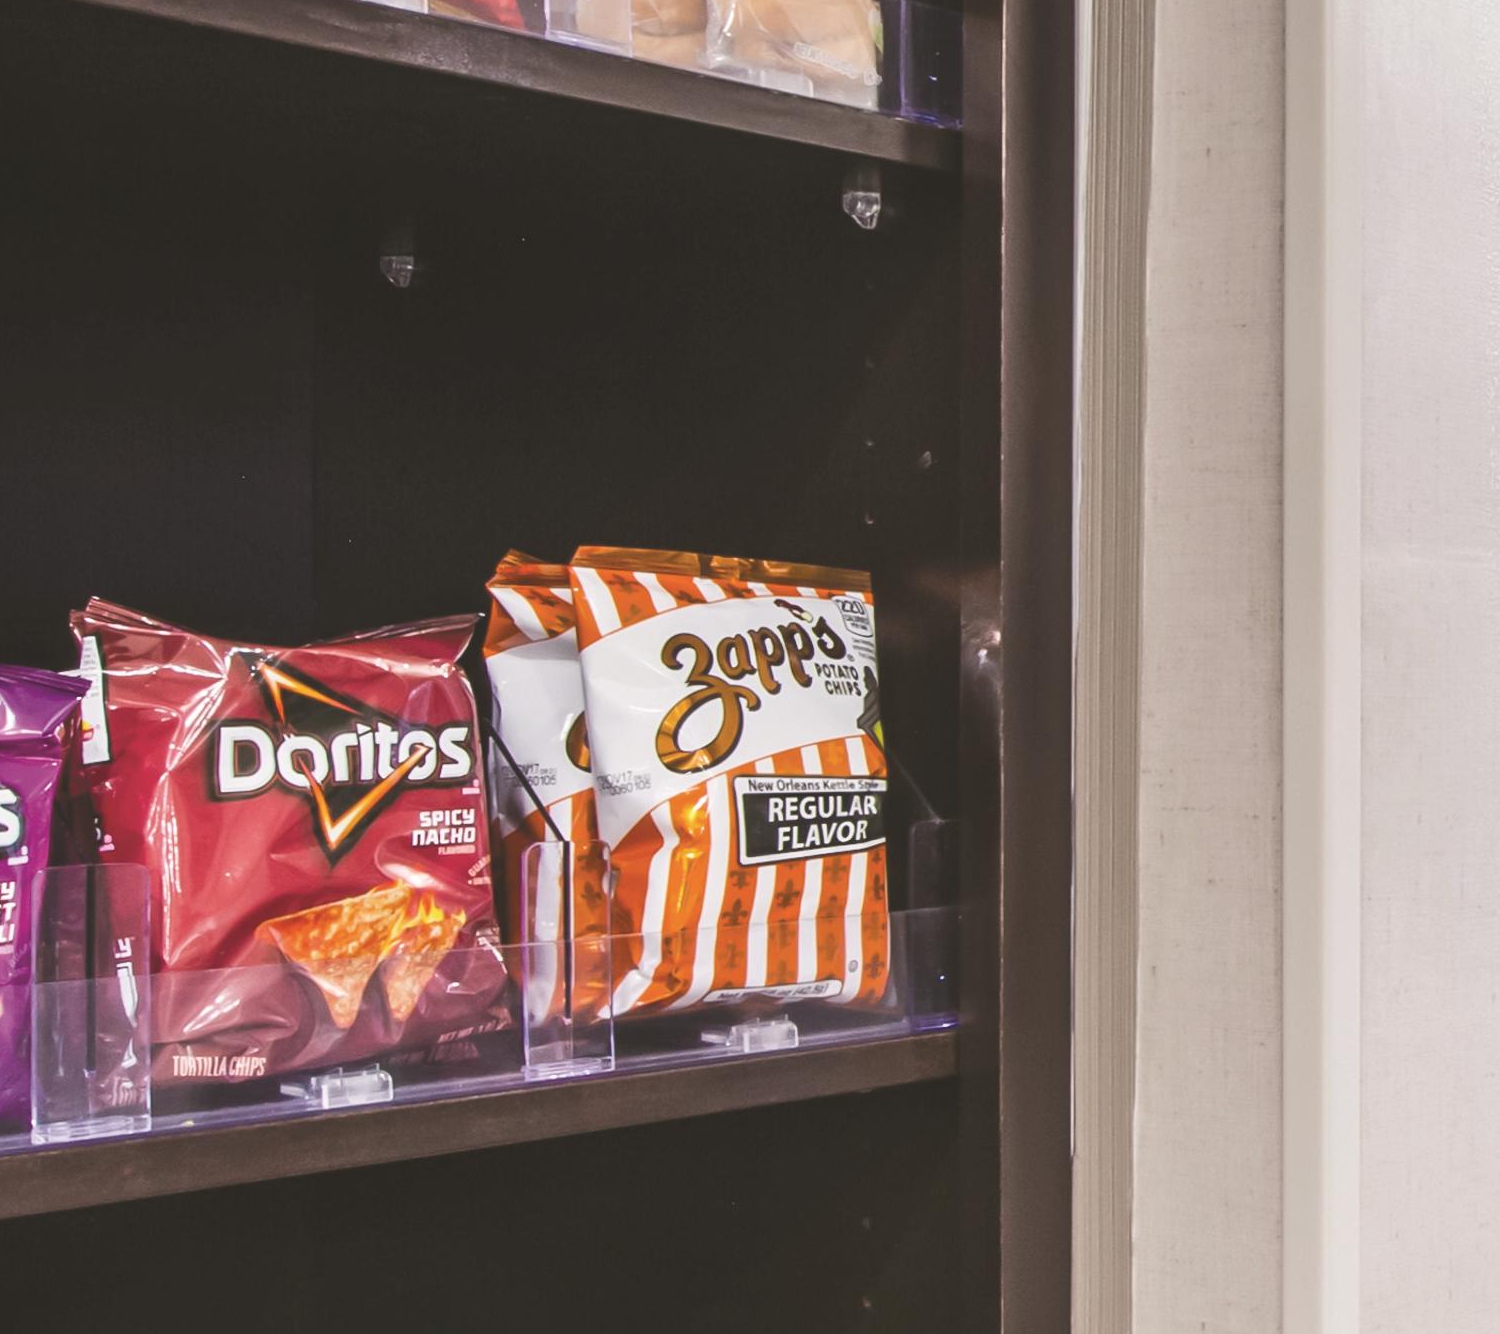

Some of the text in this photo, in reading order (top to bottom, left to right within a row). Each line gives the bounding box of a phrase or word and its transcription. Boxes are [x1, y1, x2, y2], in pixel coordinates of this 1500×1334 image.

[814, 662, 860, 680] POTATO
[824, 678, 863, 697] CHIPS
[219, 724, 474, 795] Doritos
[747, 779, 774, 792] New
[775, 778, 821, 791] Orleans
[419, 808, 476, 828] SPICY
[767, 794, 879, 824] REGULAR
[411, 826, 477, 847] NACHO
[776, 820, 869, 852] FLAVOR
[172, 1055, 267, 1078] TORTILLA CHIPS
